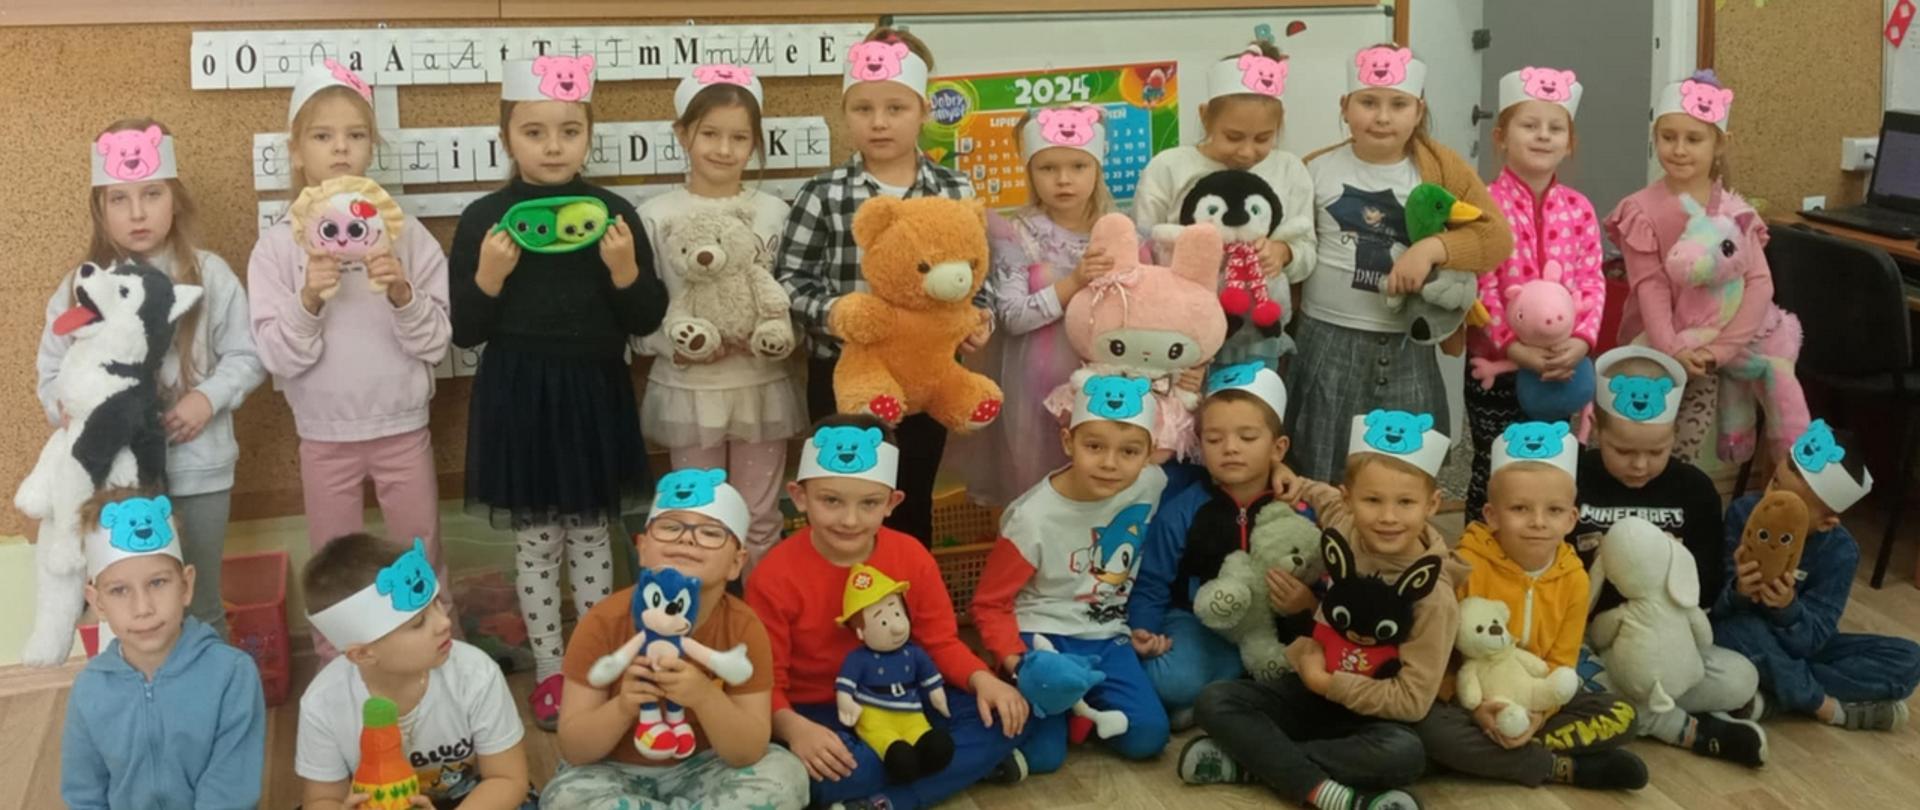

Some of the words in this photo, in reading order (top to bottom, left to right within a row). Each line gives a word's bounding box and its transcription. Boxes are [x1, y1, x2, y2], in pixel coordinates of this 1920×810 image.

[202, 54, 216, 76] o
[236, 44, 257, 74] O
[349, 50, 363, 71] a
[385, 44, 404, 72] A
[423, 53, 440, 70] a
[639, 45, 661, 65] m
[674, 37, 698, 65] M
[785, 44, 798, 64] e
[820, 36, 836, 63] E
[1014, 73, 1091, 105] 2024
[990, 117, 1021, 128] LIPIE
[452, 141, 461, 168] i
[488, 140, 499, 167] I
[630, 135, 649, 162] D
[769, 129, 789, 156] K
[807, 128, 822, 155] k
[1533, 701, 1636, 749] ATMAN
